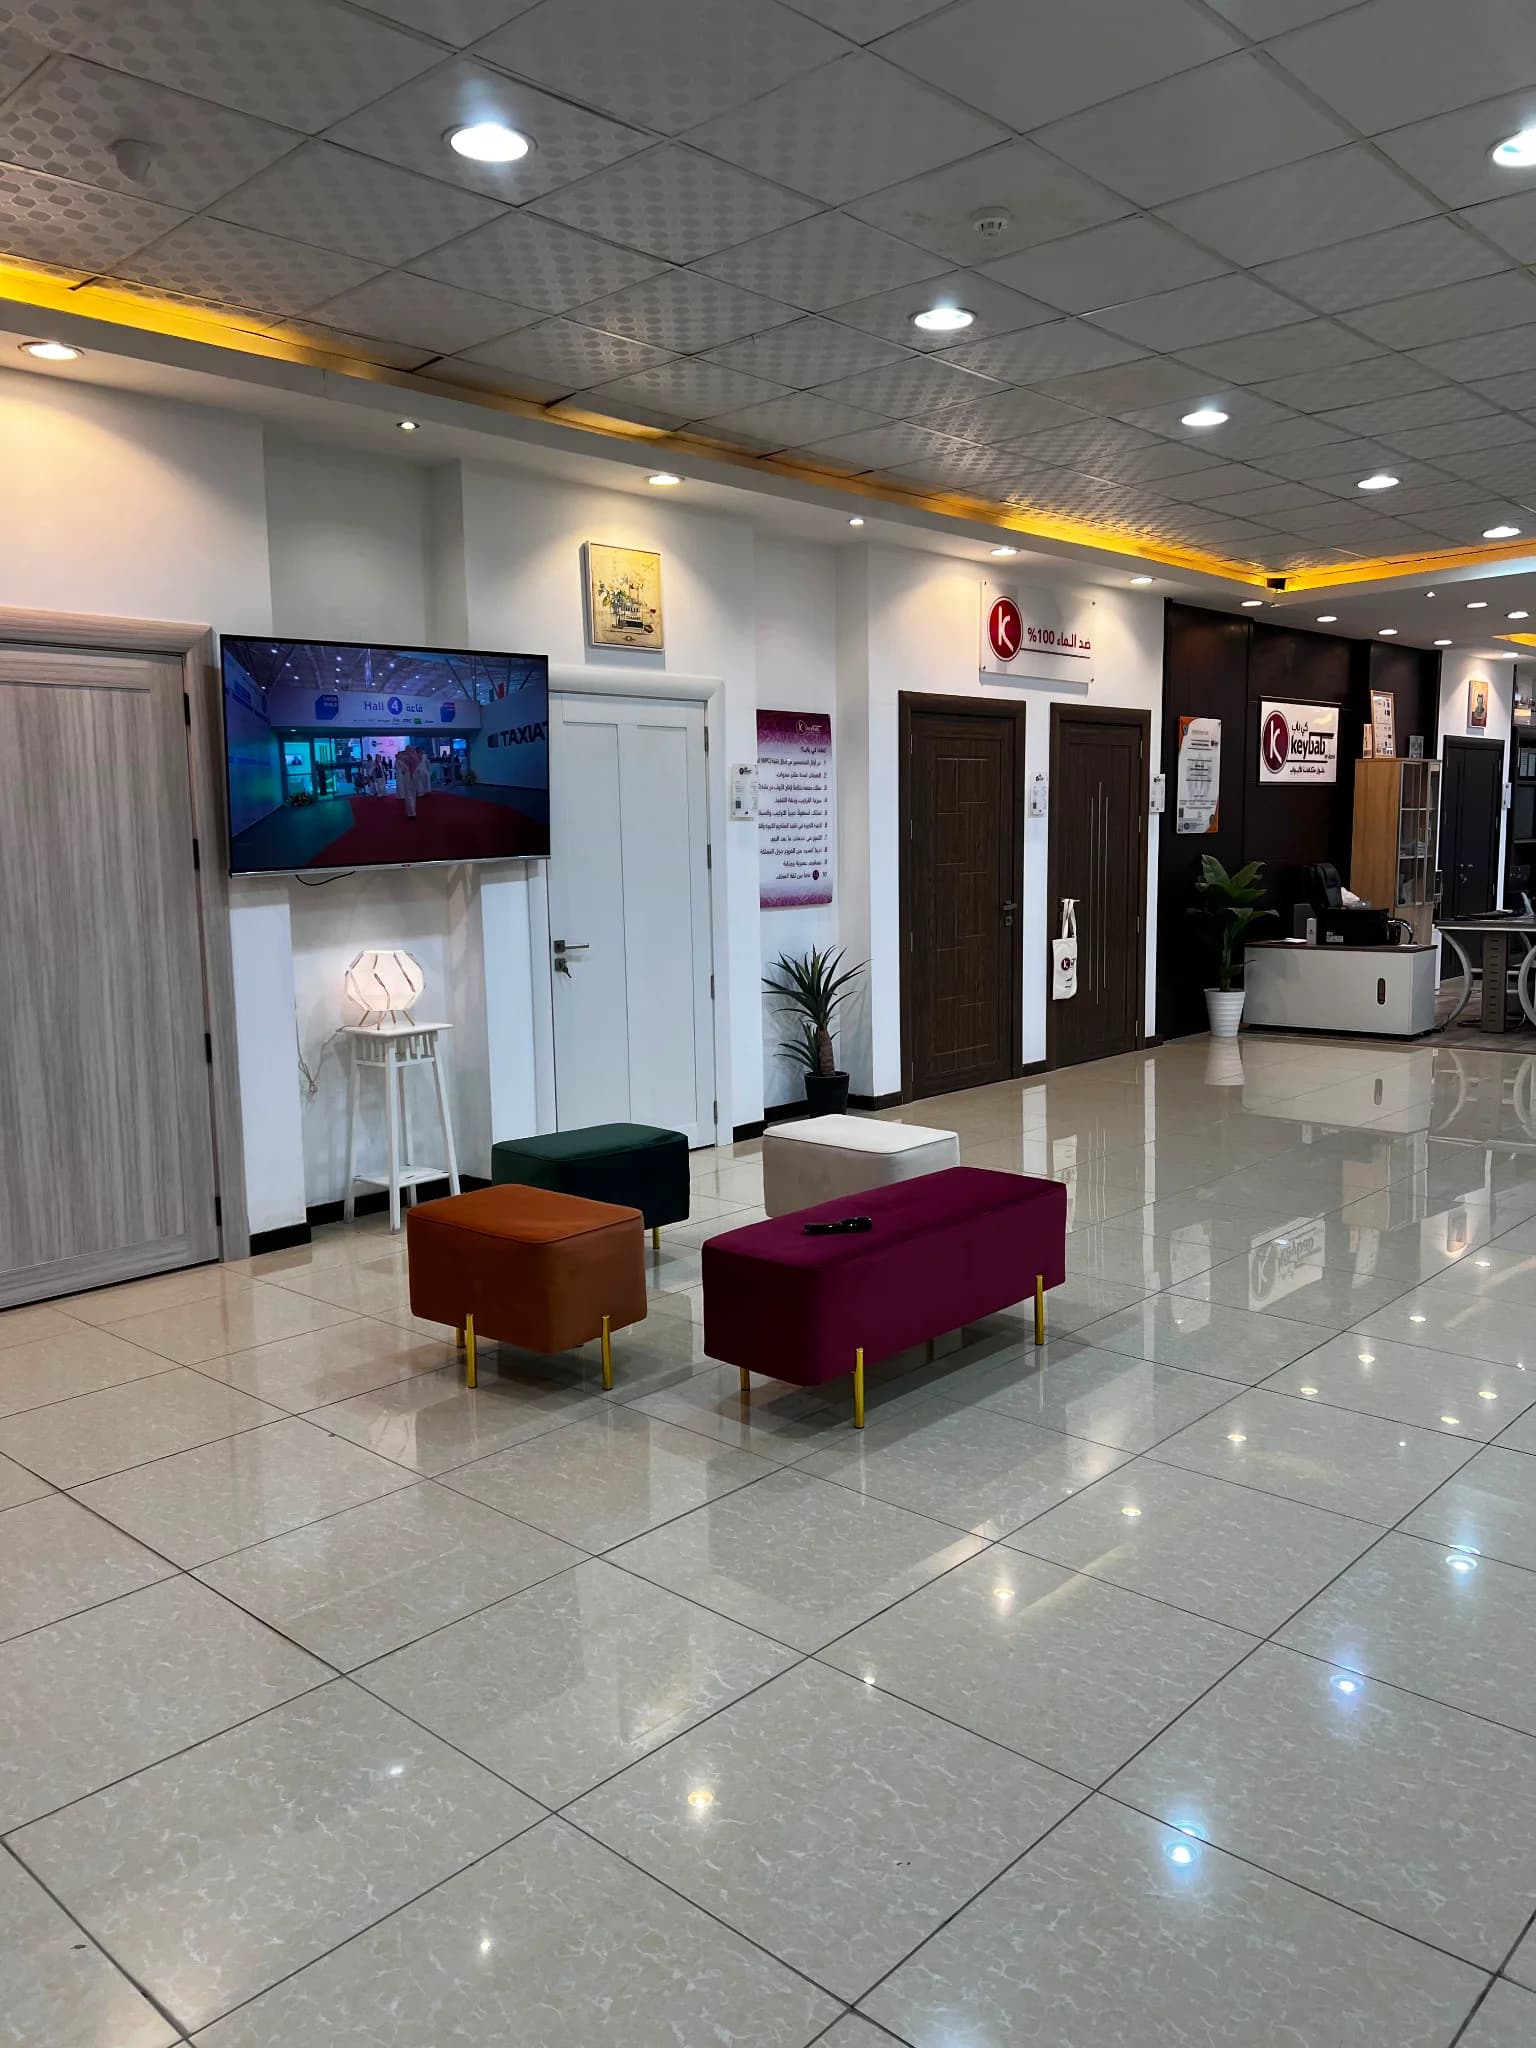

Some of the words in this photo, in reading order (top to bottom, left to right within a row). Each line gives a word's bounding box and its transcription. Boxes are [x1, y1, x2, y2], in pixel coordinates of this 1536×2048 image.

[1057, 632, 1077, 648] الماء
[364, 701, 384, 711] Hall
[391, 700, 399, 712] 4
[1290, 734, 1326, 759] keybab
